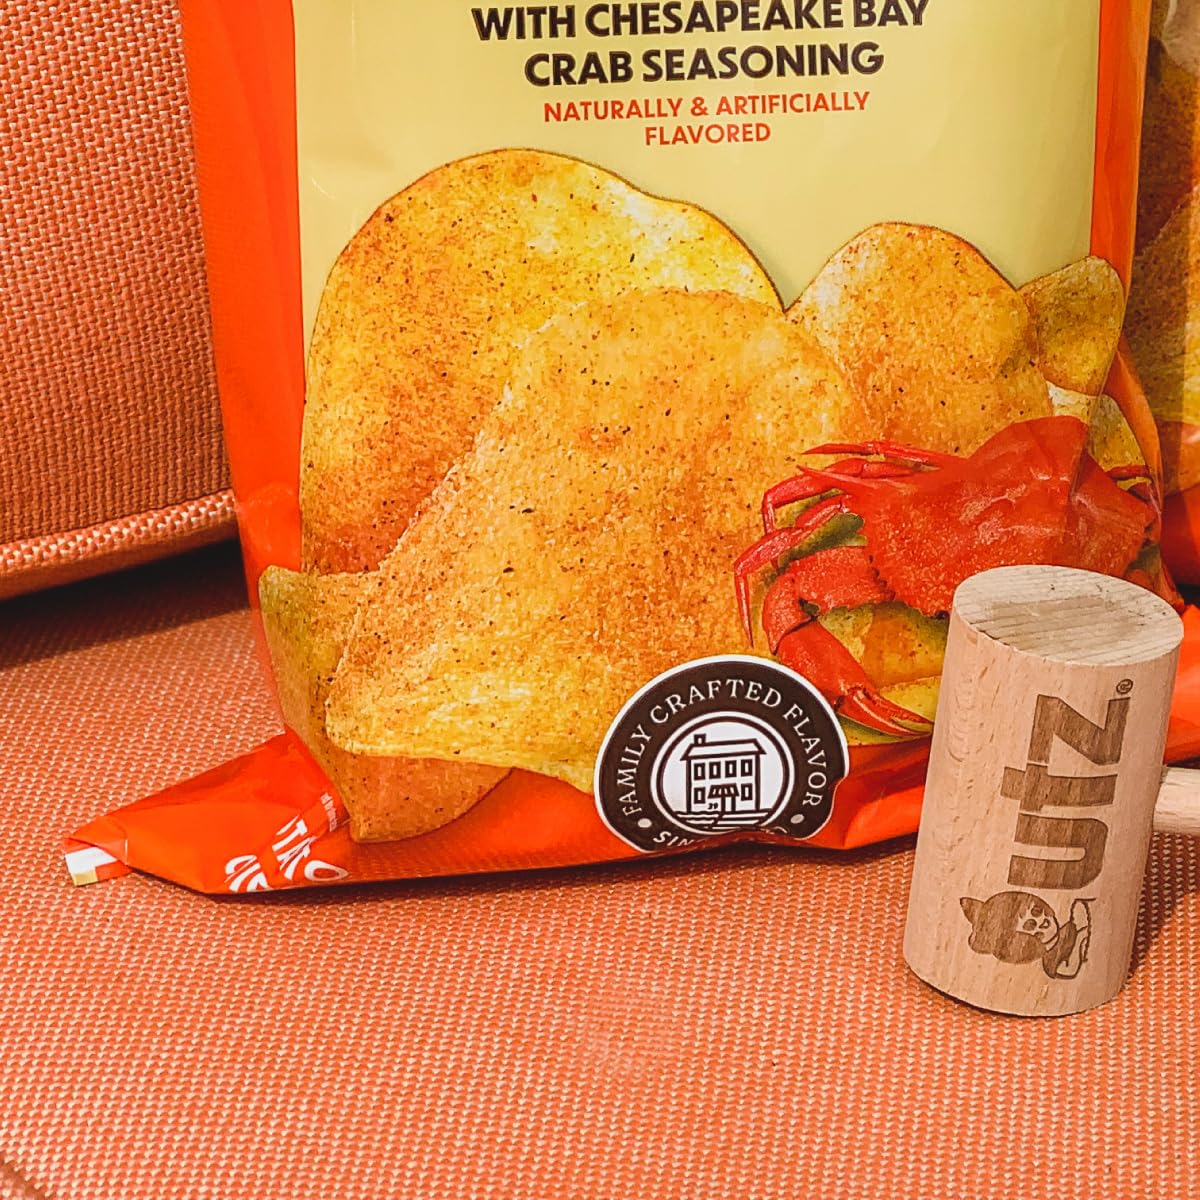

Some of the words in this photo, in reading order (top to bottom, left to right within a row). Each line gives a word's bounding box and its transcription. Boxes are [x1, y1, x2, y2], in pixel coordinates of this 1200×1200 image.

[471, 4, 576, 41] WITH
[524, 50, 634, 87] CRAB
[641, 41, 885, 83] SEASONING
[543, 97, 684, 123] NATURALLY
[690, 97, 709, 117] &
[715, 91, 871, 116] ARTIFICIALLY
[644, 122, 771, 146] FLAVORED
[617, 724, 652, 816] FAMILY
[650, 678, 782, 724] CRAFTED
[782, 704, 827, 807] FLAVOR
